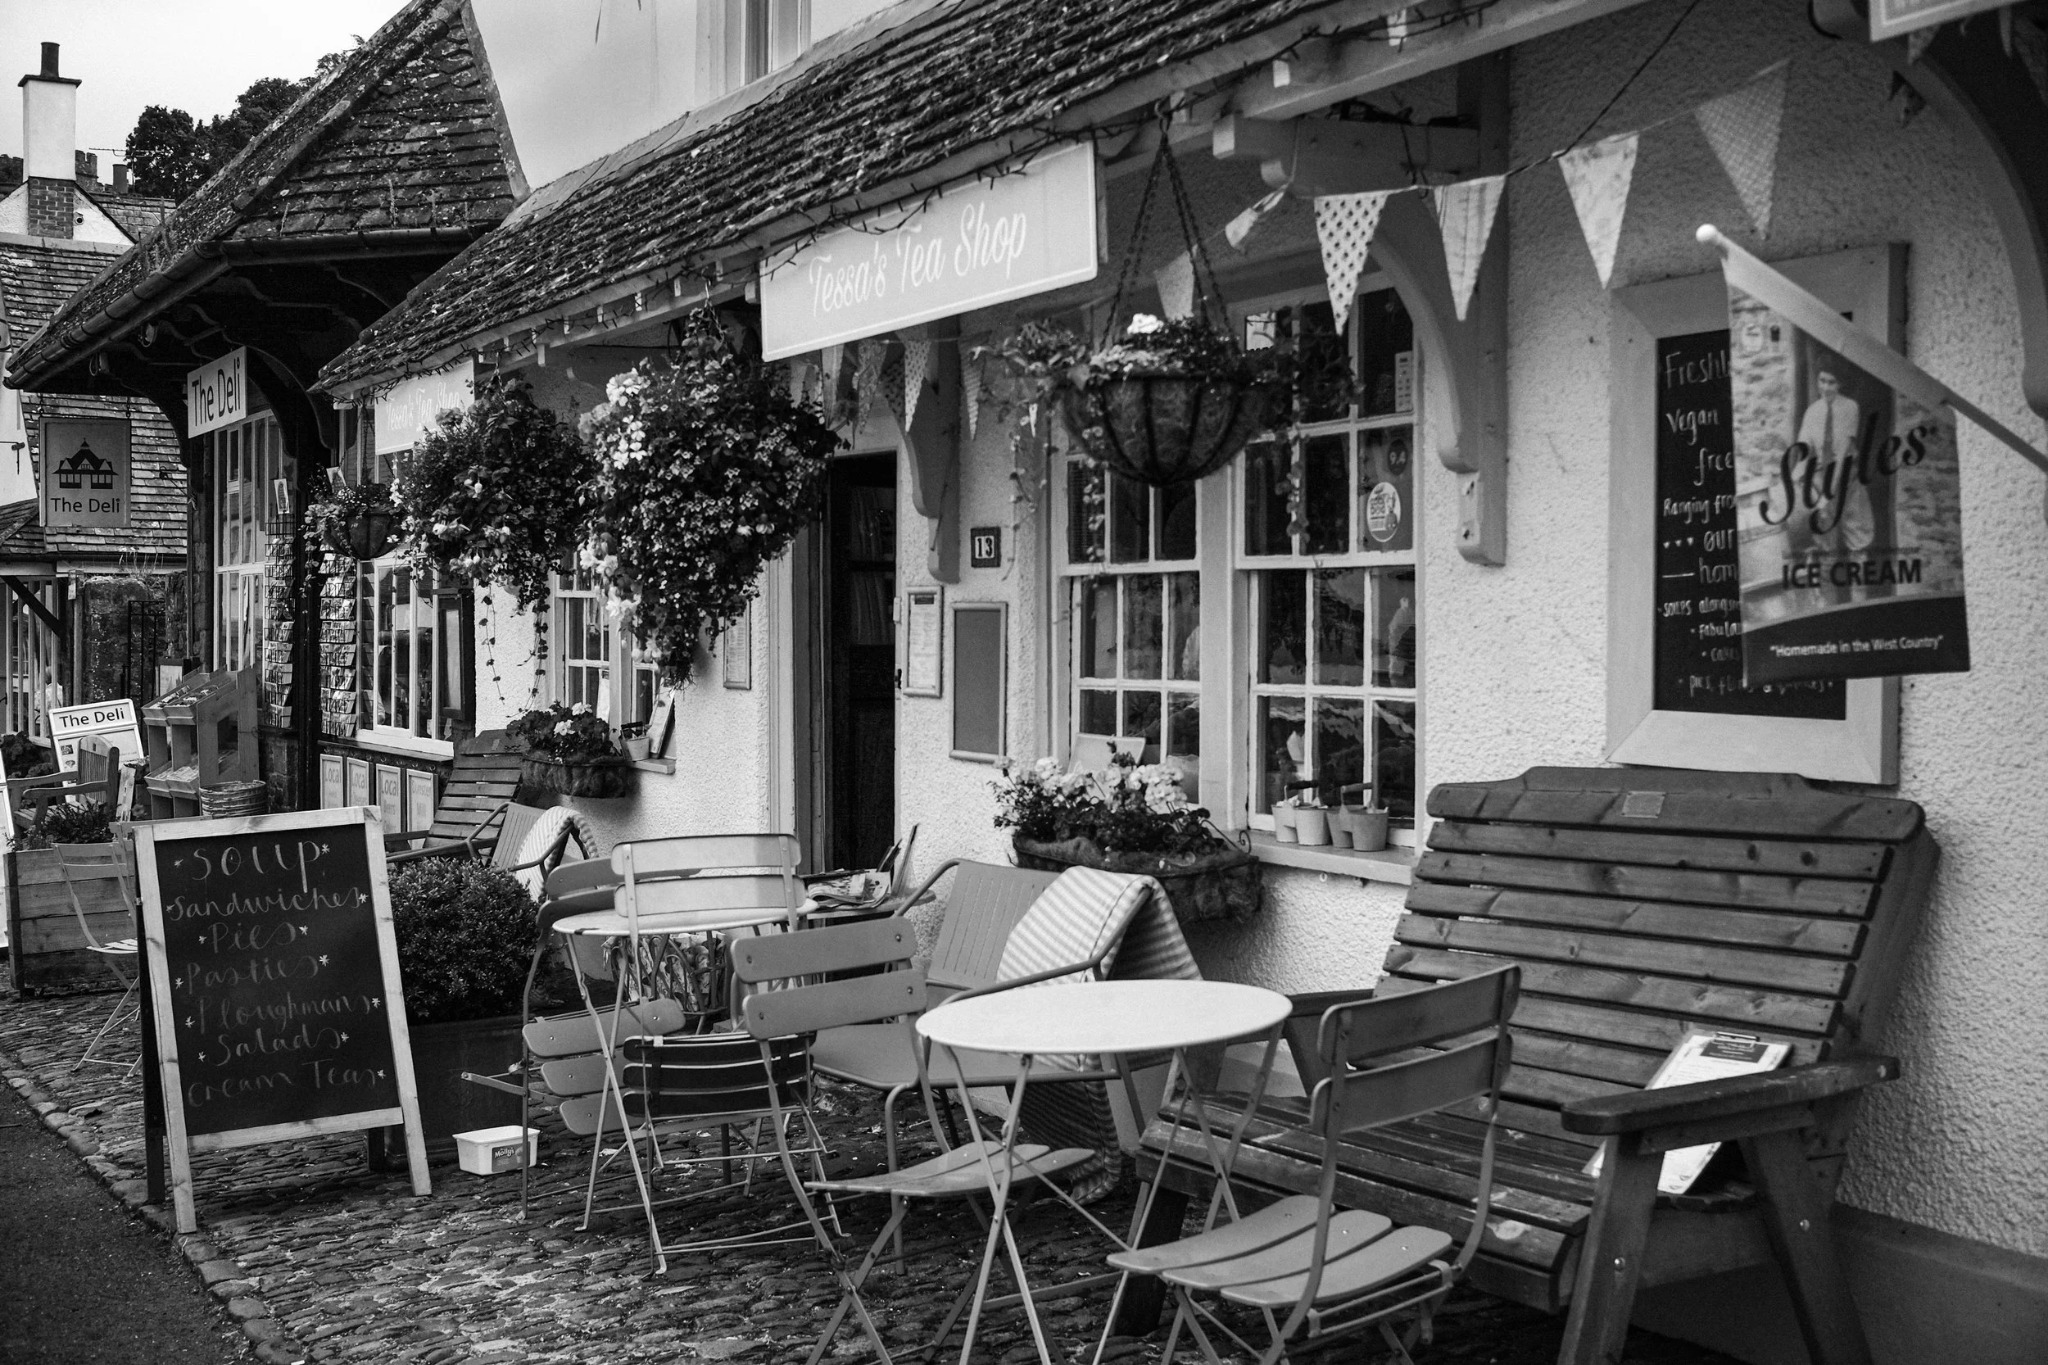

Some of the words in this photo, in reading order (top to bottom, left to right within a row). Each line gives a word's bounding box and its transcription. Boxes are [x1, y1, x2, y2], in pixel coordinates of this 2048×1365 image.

[809, 240, 887, 317] Tessa's
[895, 225, 945, 293] Tea
[954, 202, 1027, 280] Shop
[1665, 350, 1731, 389] Freshl
[192, 375, 214, 427] The
[218, 357, 241, 417] Deli
[1759, 412, 1930, 535] Styles
[50, 497, 83, 513] The
[89, 497, 121, 514] Deli
[976, 537, 994, 557] 13
[1782, 563, 1822, 590] ICE
[1829, 559, 1923, 587] CREAM
[1839, 639, 1850, 653] in
[1852, 638, 1871, 652] the
[1872, 637, 1898, 651] West
[59, 714, 89, 728] The
[94, 707, 125, 724] Deli
[170, 887, 360, 921] Sandwiches
[208, 922, 296, 954] Pies
[187, 955, 319, 995] Pasties
[216, 1023, 341, 1067] Salads
[301, 1058, 376, 1089] Teas
